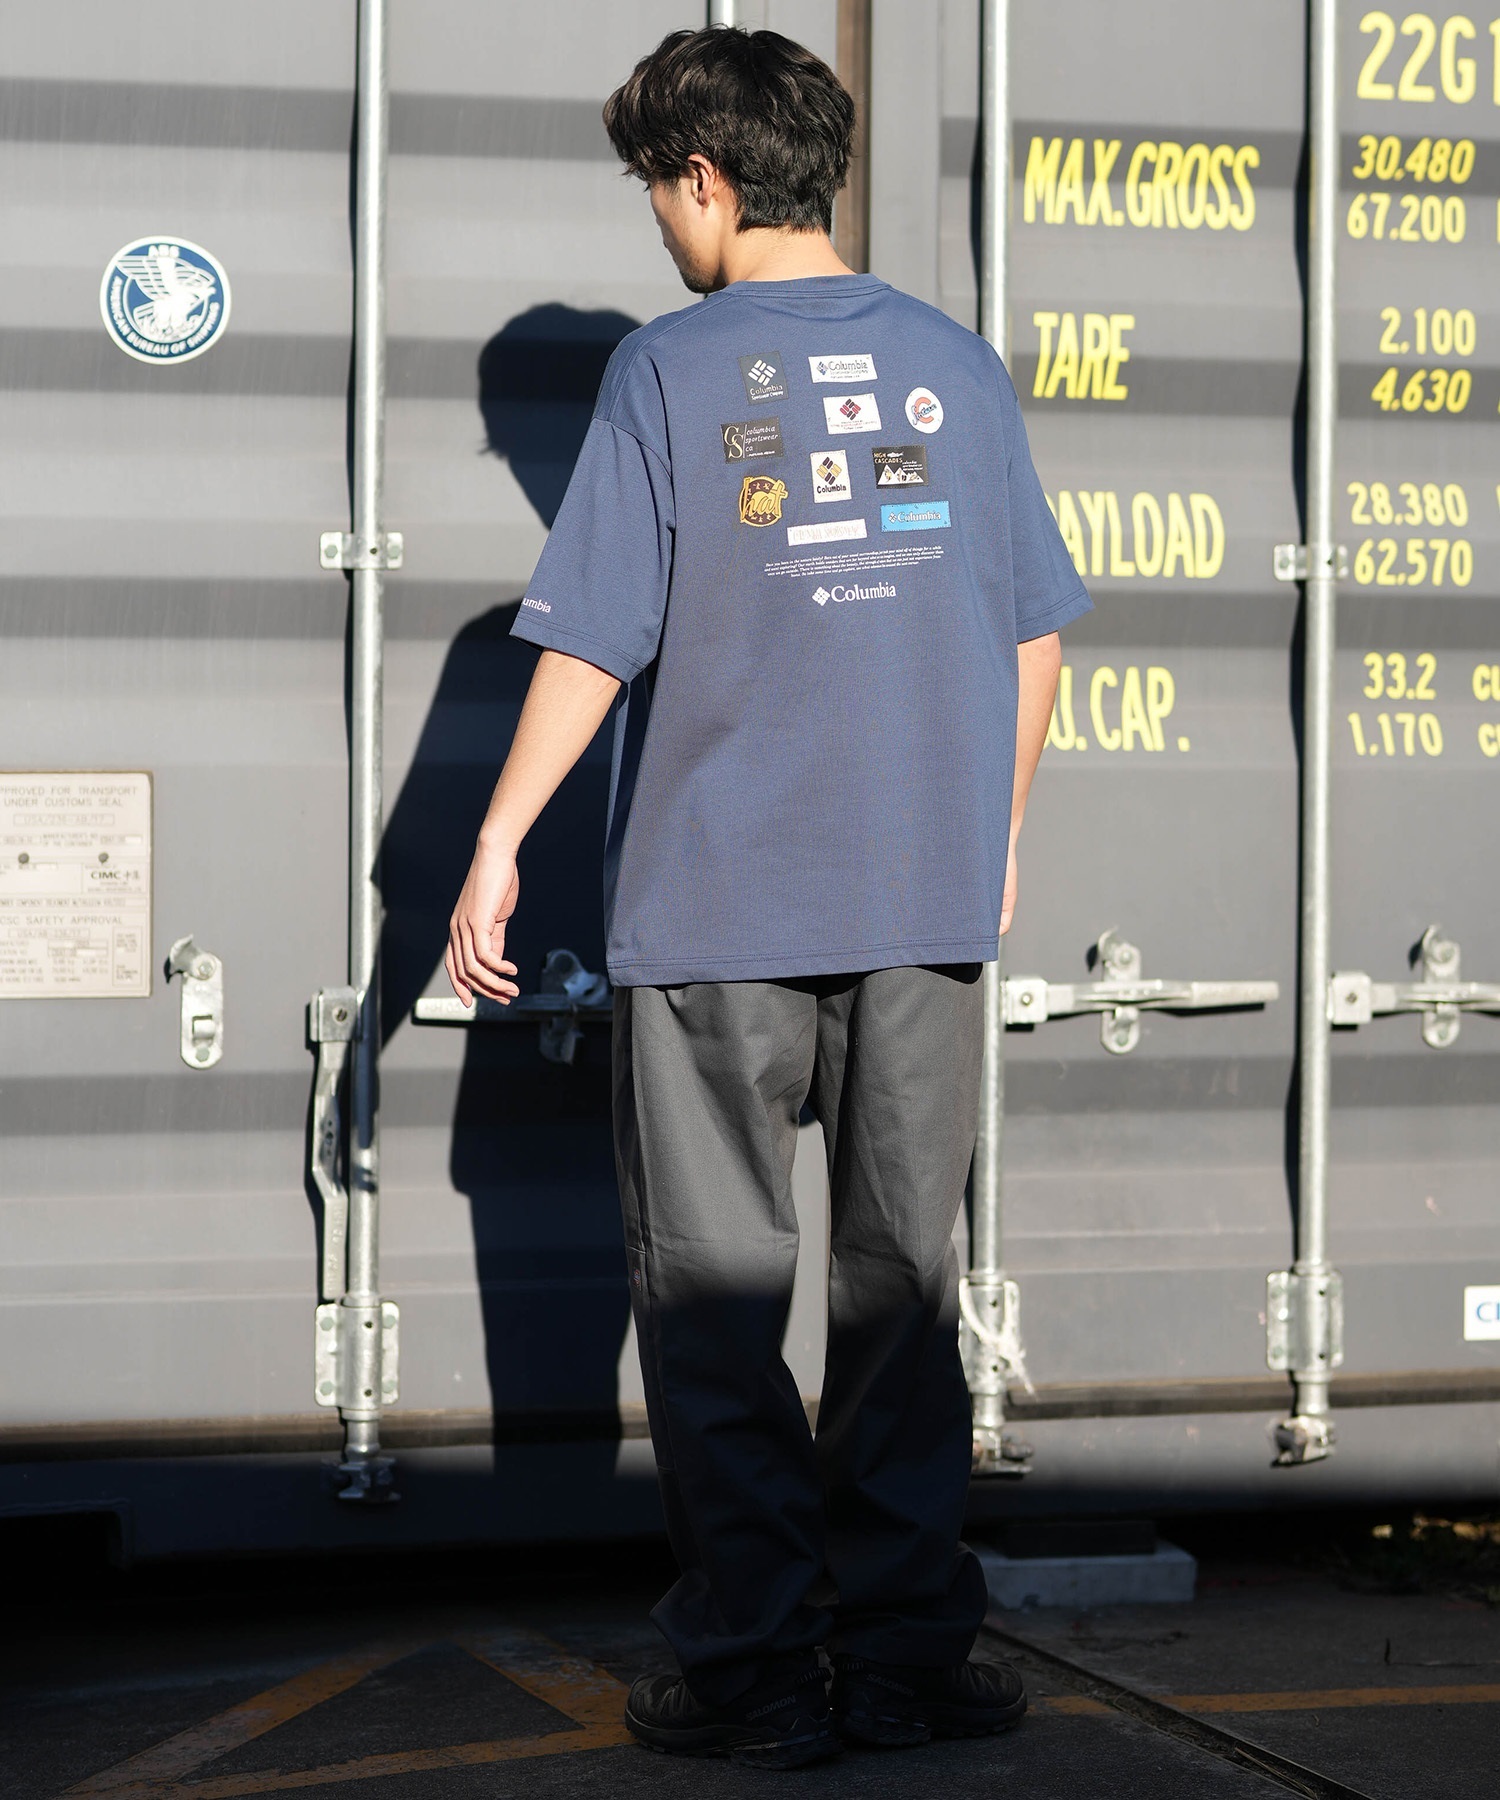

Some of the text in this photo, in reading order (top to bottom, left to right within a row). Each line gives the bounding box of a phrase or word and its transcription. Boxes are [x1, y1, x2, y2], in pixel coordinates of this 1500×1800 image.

[1352, 134, 1477, 184] 30.480
[1023, 136, 1261, 231] MAX.GROSS
[1347, 192, 1467, 244] 67.200
[126, 331, 170, 355] BUREAU
[171, 341, 187, 354] OF
[1379, 306, 1477, 357] 2.100
[1032, 311, 1136, 401] TARE
[749, 385, 783, 397] Columbia
[1371, 366, 1473, 413] 4.630
[816, 484, 847, 494] Columbia
[1347, 481, 1469, 527] 28.380
[897, 510, 941, 522] Columbia
[1044, 490, 1226, 579] AYLOAD
[1354, 538, 1474, 587] 62.570
[830, 582, 897, 603] Columbia
[1363, 652, 1437, 701] 33.2
[1043, 666, 1191, 752] U.CAP.
[1348, 712, 1444, 757] 1.170
[4, 797, 123, 808] UNDER CUSTOMS SEAL
[51, 786, 71, 796] FOR
[78, 786, 138, 796] TRANSPORT
[91, 870, 121, 880] CIMC
[0, 915, 123, 925] CSC SAFETY APPROVAL
[745, 1694, 797, 1722] SALOMON
